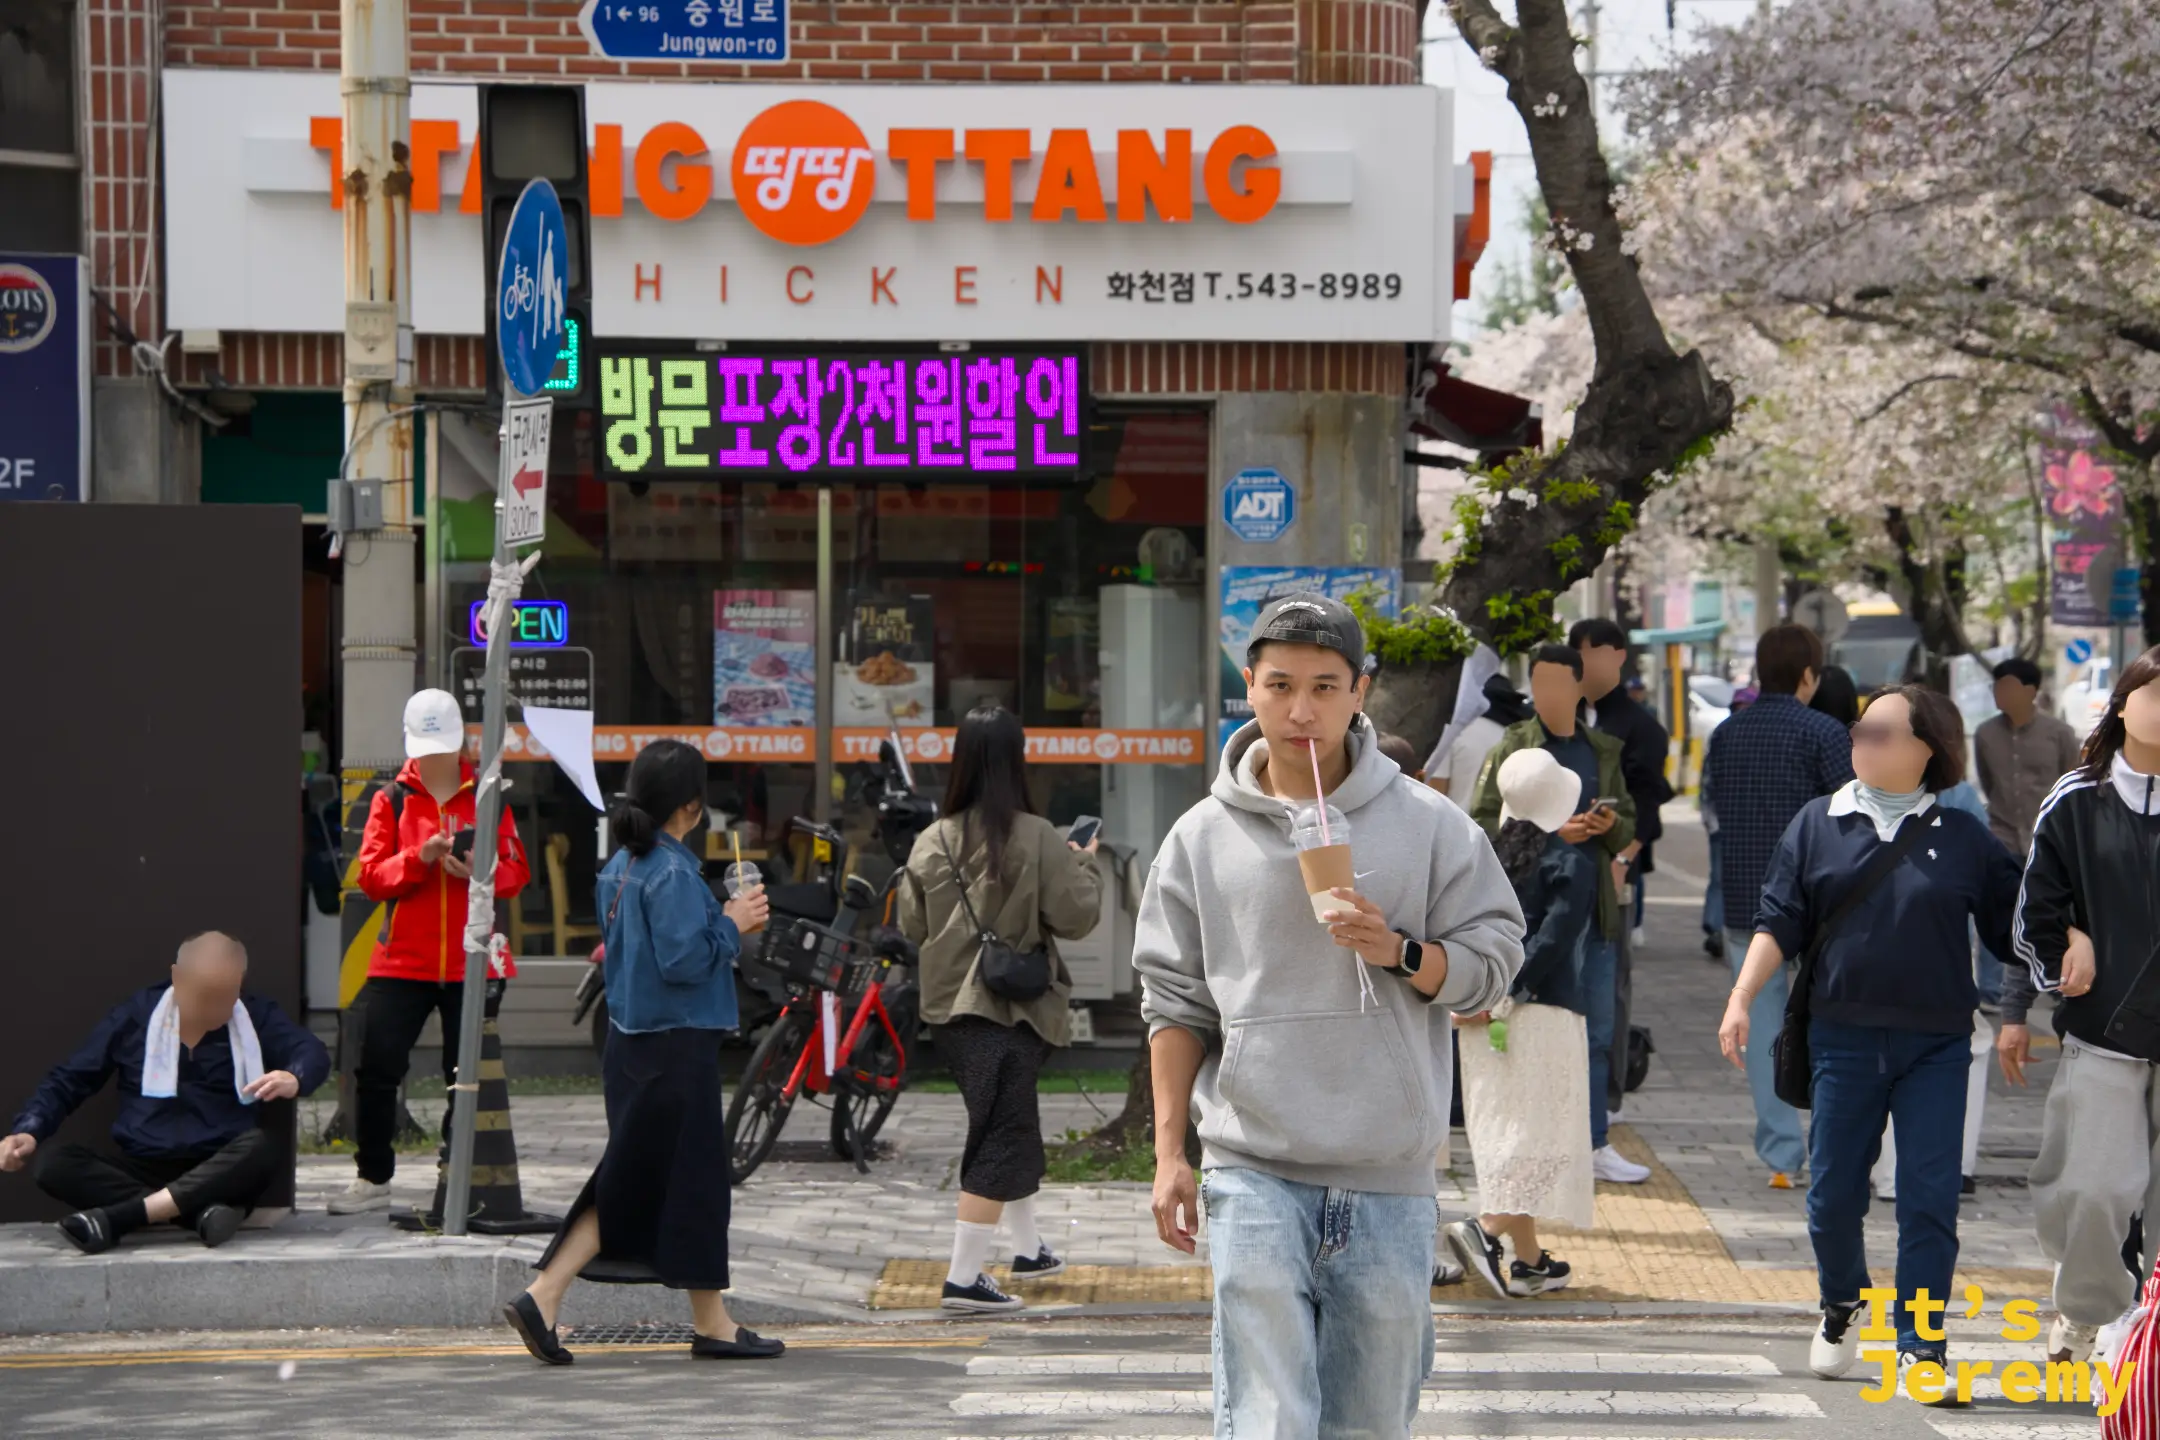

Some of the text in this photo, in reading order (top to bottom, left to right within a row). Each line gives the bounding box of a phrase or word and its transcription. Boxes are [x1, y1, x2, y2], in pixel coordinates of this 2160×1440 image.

[638, 6, 660, 22] 96
[683, 0, 778, 28] 중원로
[658, 32, 777, 56] Jungwon-ro
[743, 146, 873, 211] 땅땅
[888, 124, 1281, 224] TTANG
[1107, 270, 1402, 303] 화천점 T.543-8989
[512, 411, 548, 459] 구간시작
[1232, 491, 1285, 519] ADT
[510, 505, 539, 536] 300m
[733, 734, 805, 755] TTANG
[1121, 736, 1194, 757] TTANG
